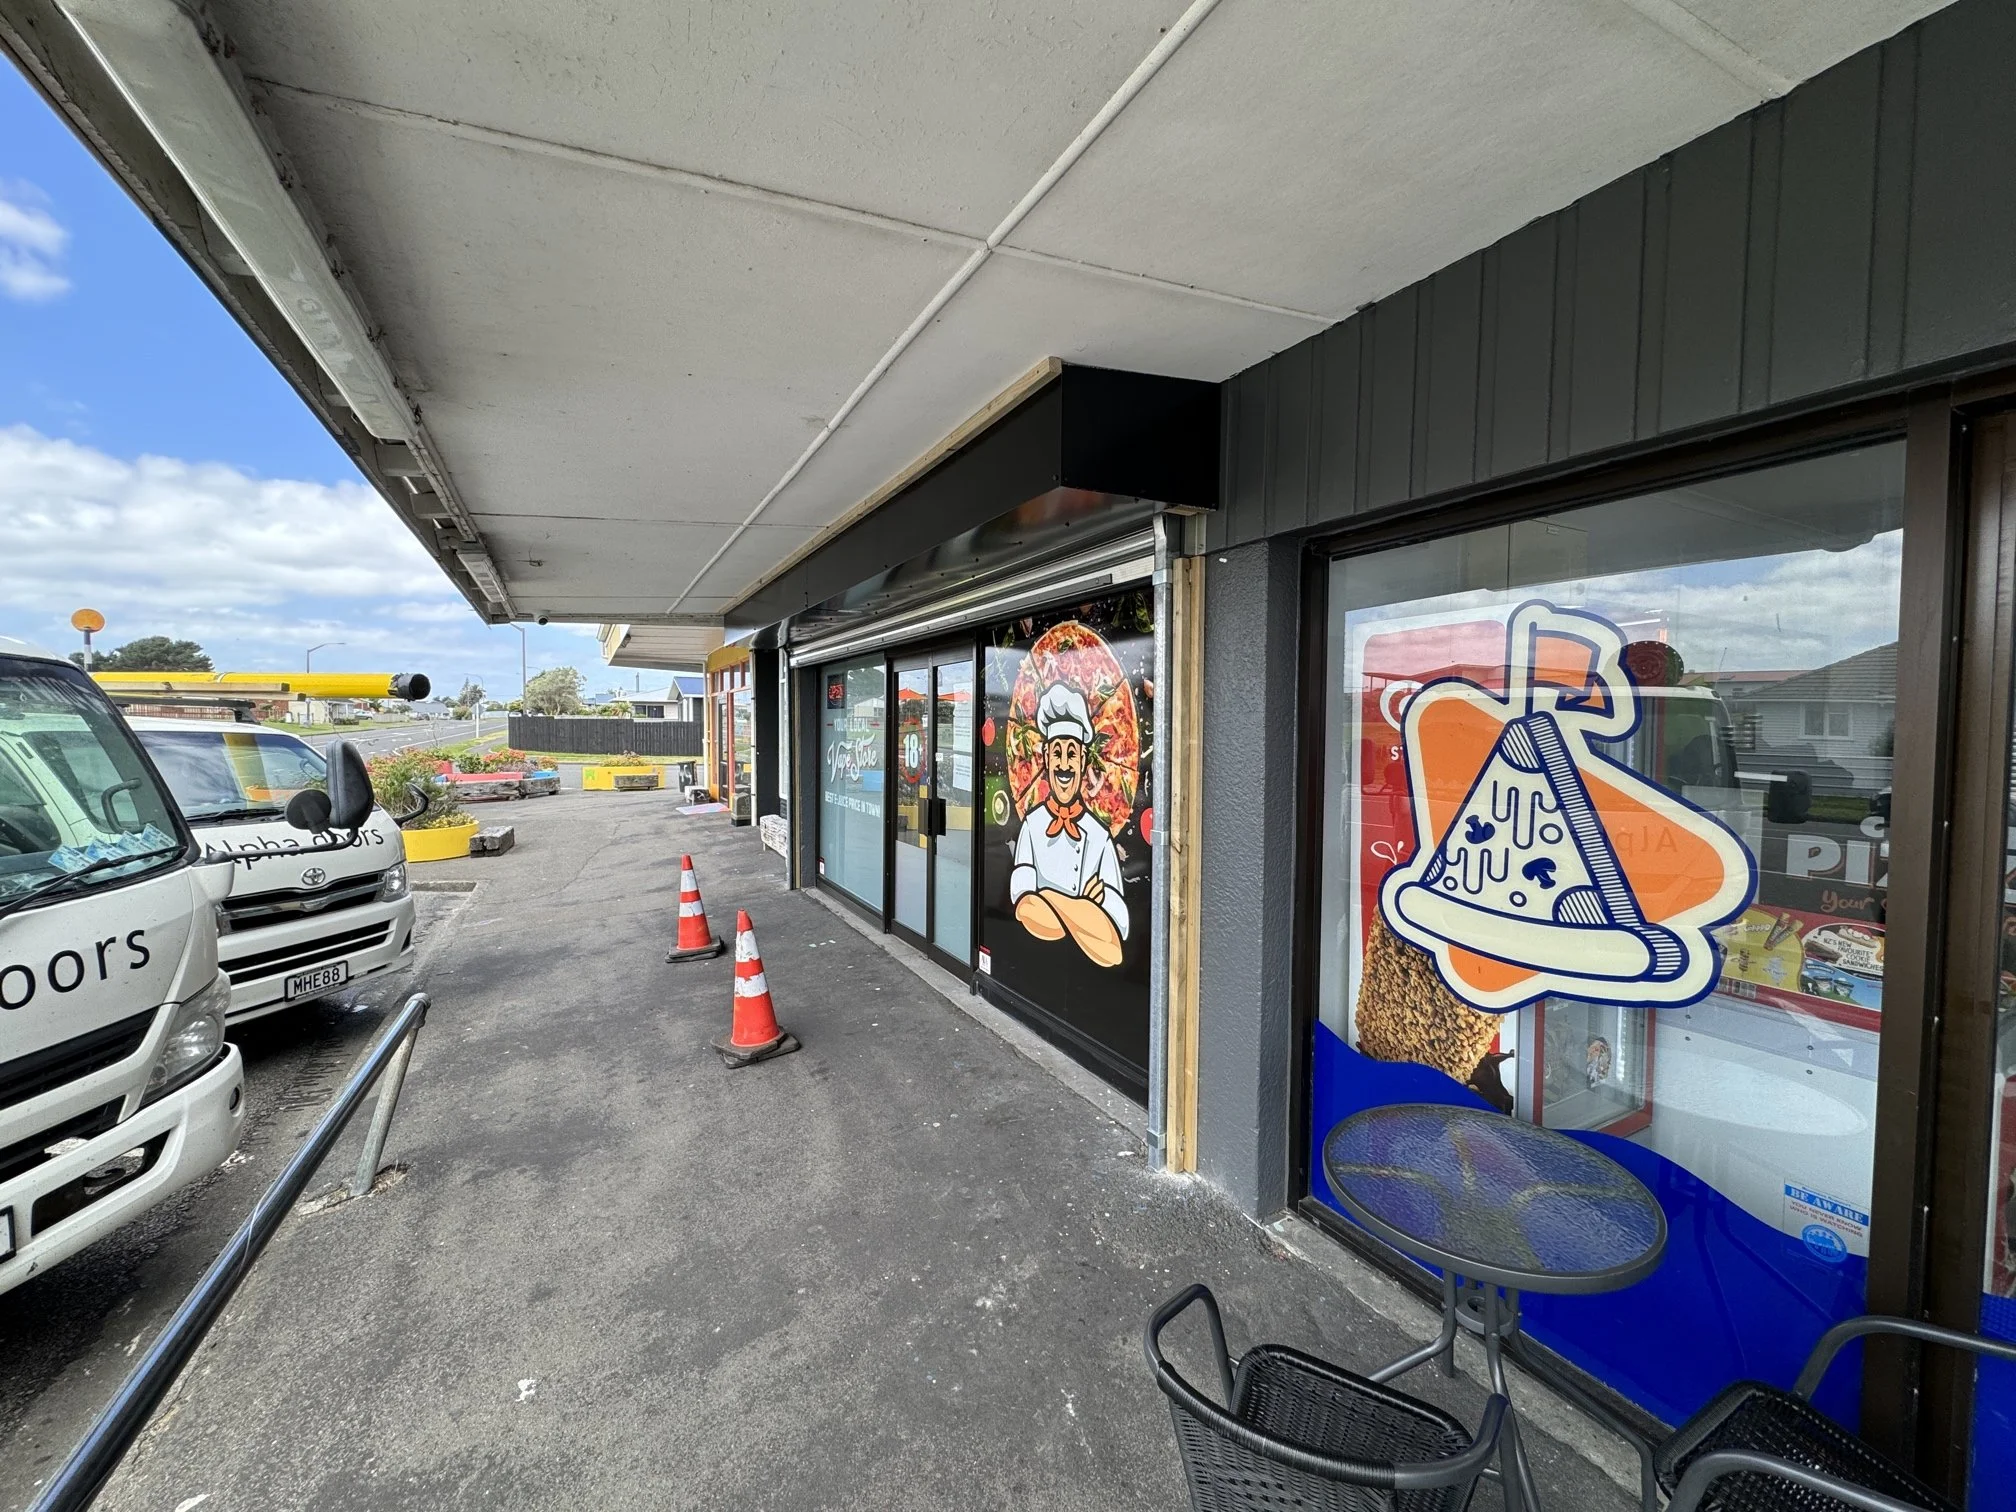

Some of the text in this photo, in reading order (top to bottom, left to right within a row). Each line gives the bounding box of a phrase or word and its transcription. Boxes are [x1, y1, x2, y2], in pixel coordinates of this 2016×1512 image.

[834, 717, 870, 732] YOUR LOCAL
[827, 732, 878, 783] Vape Store
[904, 734, 923, 768] 18+
[205, 836, 300, 870] Alpha
[1838, 940, 1852, 948] NEW
[1846, 953, 1870, 962] COOKIE
[0, 929, 150, 1010] oors
[294, 968, 340, 995] MHE88
[1790, 1205, 1808, 1216] WHO
[1819, 1216, 1863, 1238] WATCHING
[1791, 1188, 1809, 1202] BE
[1812, 1197, 1863, 1223] AWARE
[1791, 1200, 1863, 1231] YOU NEVER KNOW
